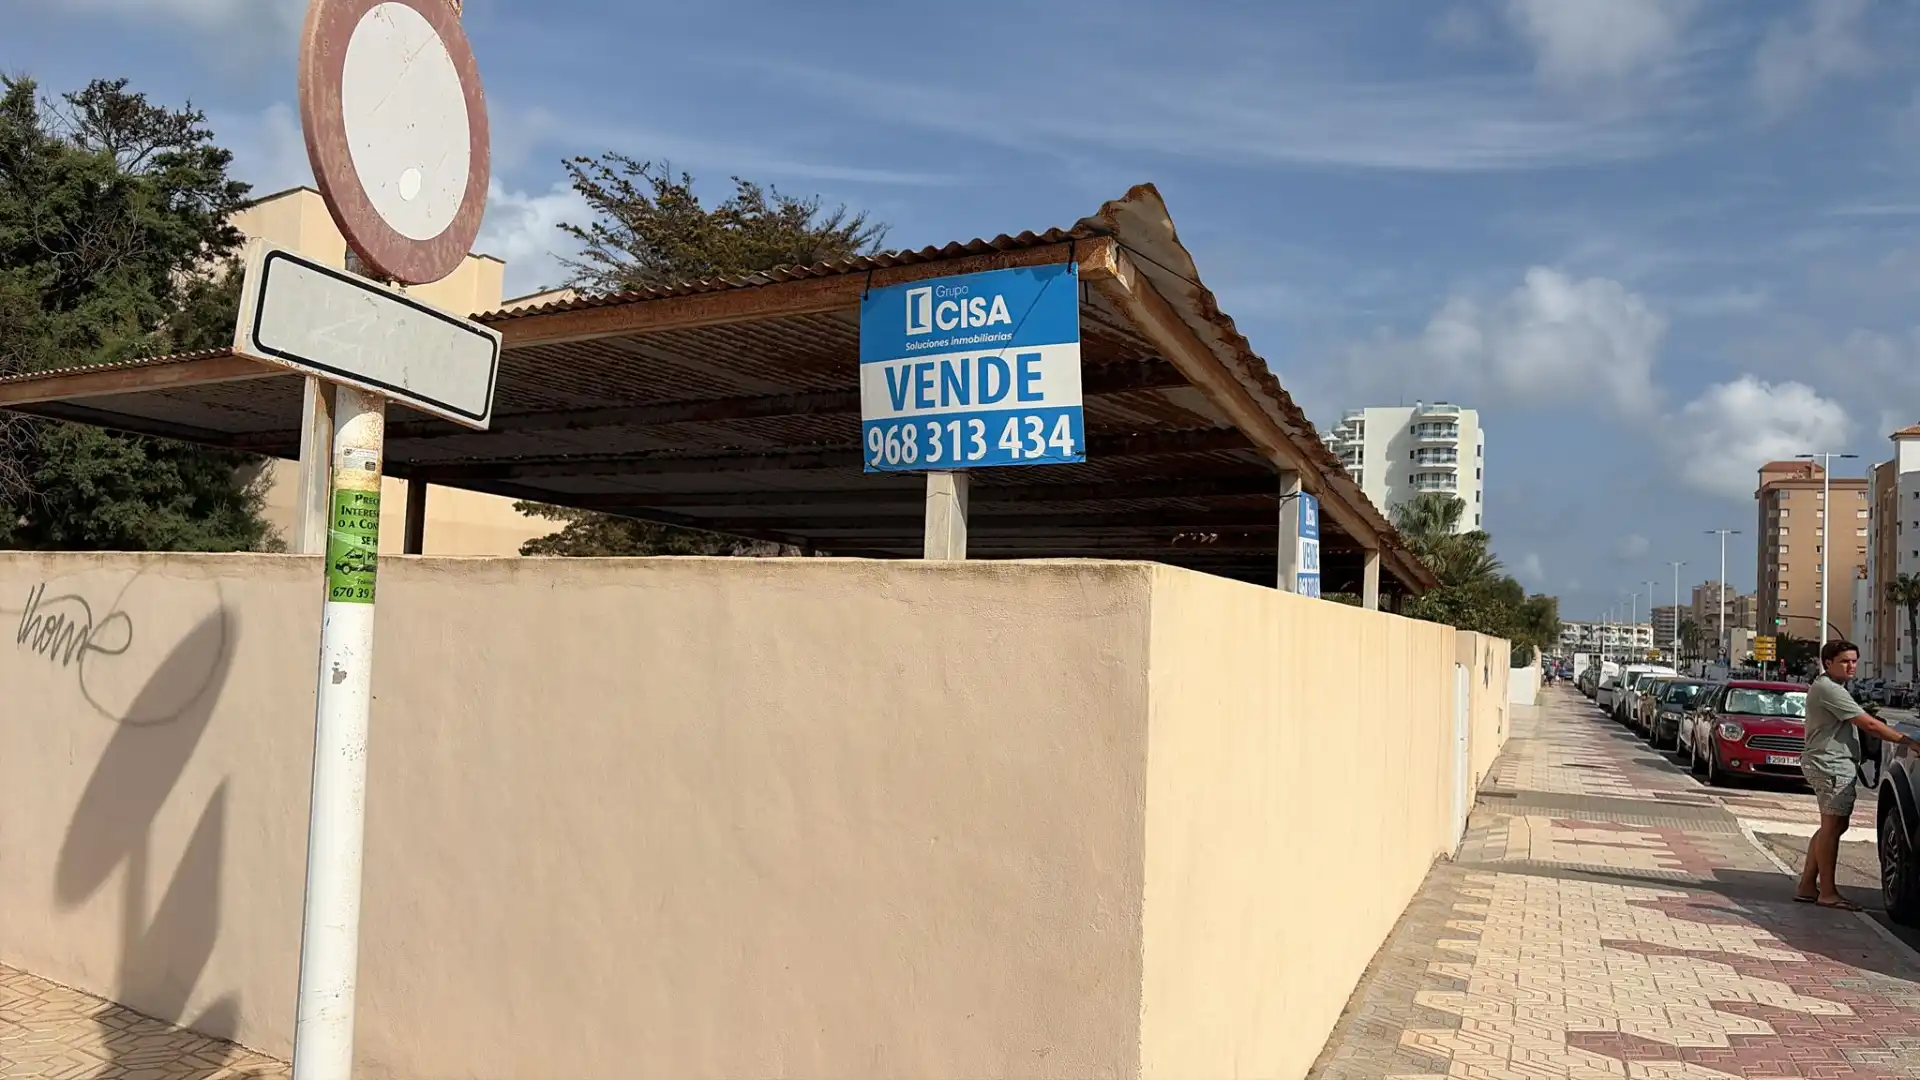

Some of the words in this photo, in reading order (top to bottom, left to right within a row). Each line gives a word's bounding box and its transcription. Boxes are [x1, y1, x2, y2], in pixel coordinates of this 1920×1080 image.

[936, 284, 969, 299] Grupo
[935, 295, 1012, 331] CISA
[905, 338, 949, 352] Soluciones
[951, 332, 1013, 346] inmobiliarias
[884, 352, 1044, 412] VENDE
[868, 423, 918, 466] 968
[925, 418, 987, 463] 313
[998, 414, 1075, 460] 434
[361, 536, 371, 545] SE
[333, 586, 354, 598] 670
